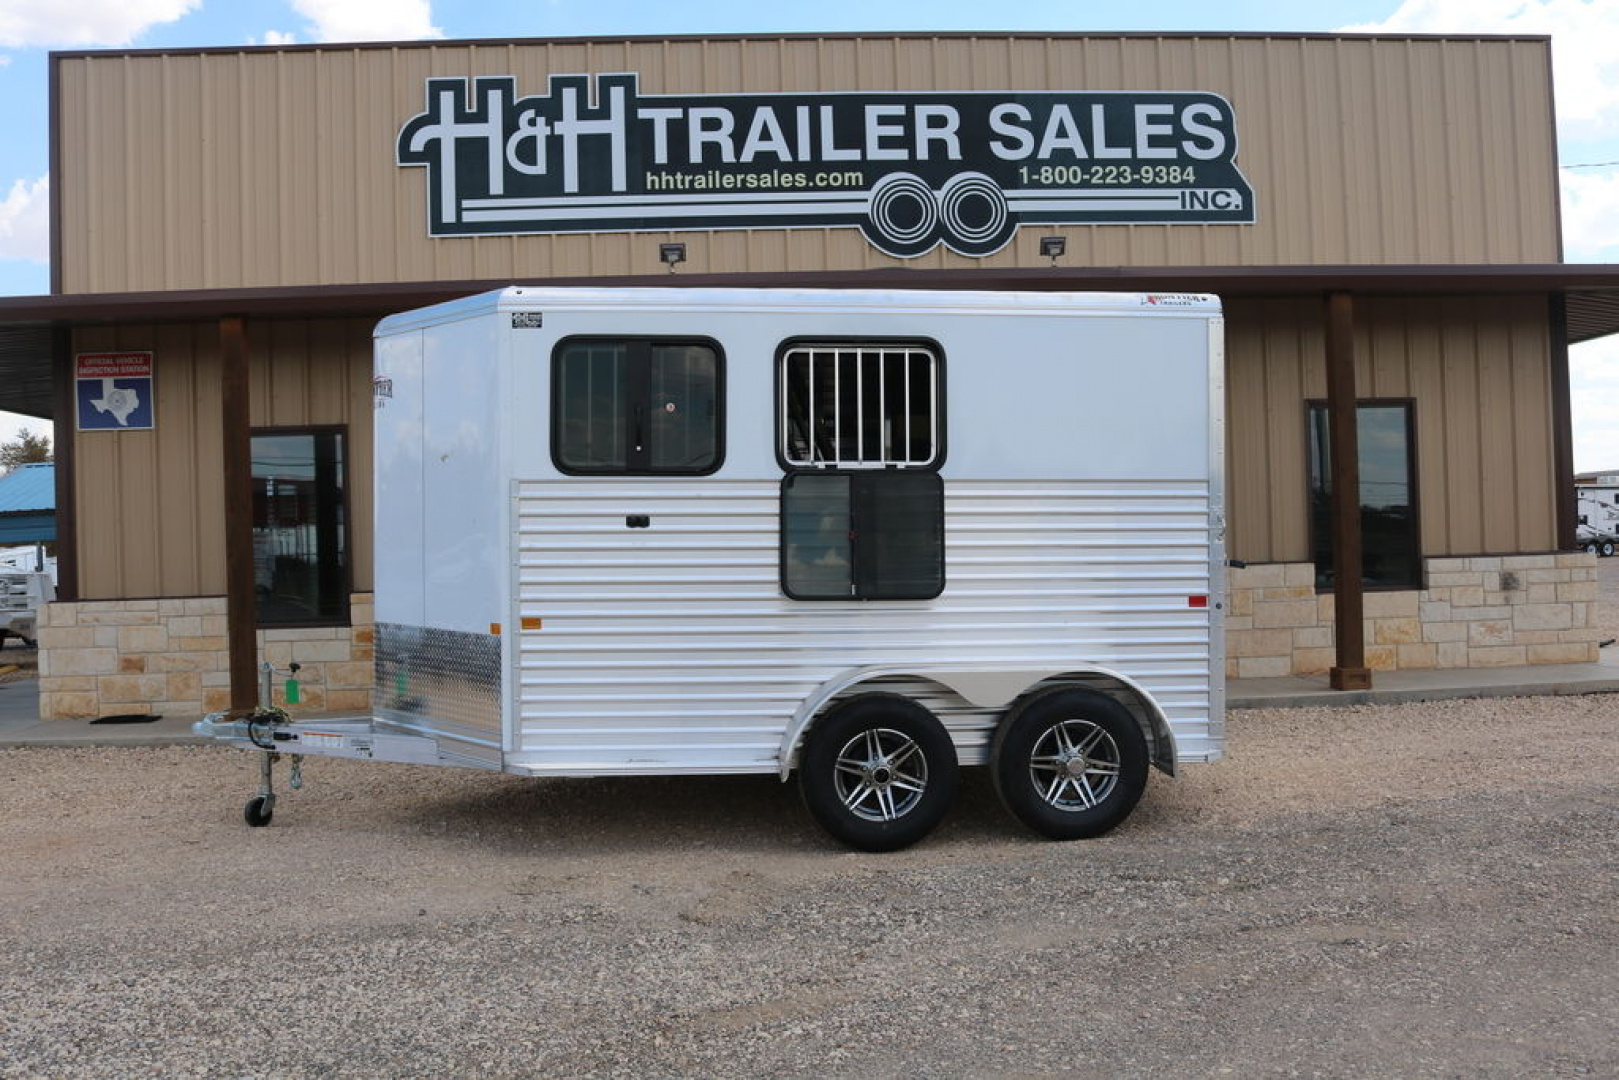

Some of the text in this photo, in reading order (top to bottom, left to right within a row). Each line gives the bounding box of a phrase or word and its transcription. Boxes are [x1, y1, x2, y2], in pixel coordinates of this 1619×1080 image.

[410, 86, 1227, 223] H&H TRAILER SALES
[645, 168, 864, 190] hhtrailersales.com
[1018, 165, 1196, 185] 1-800-223-9384
[1180, 190, 1241, 210] INC.
